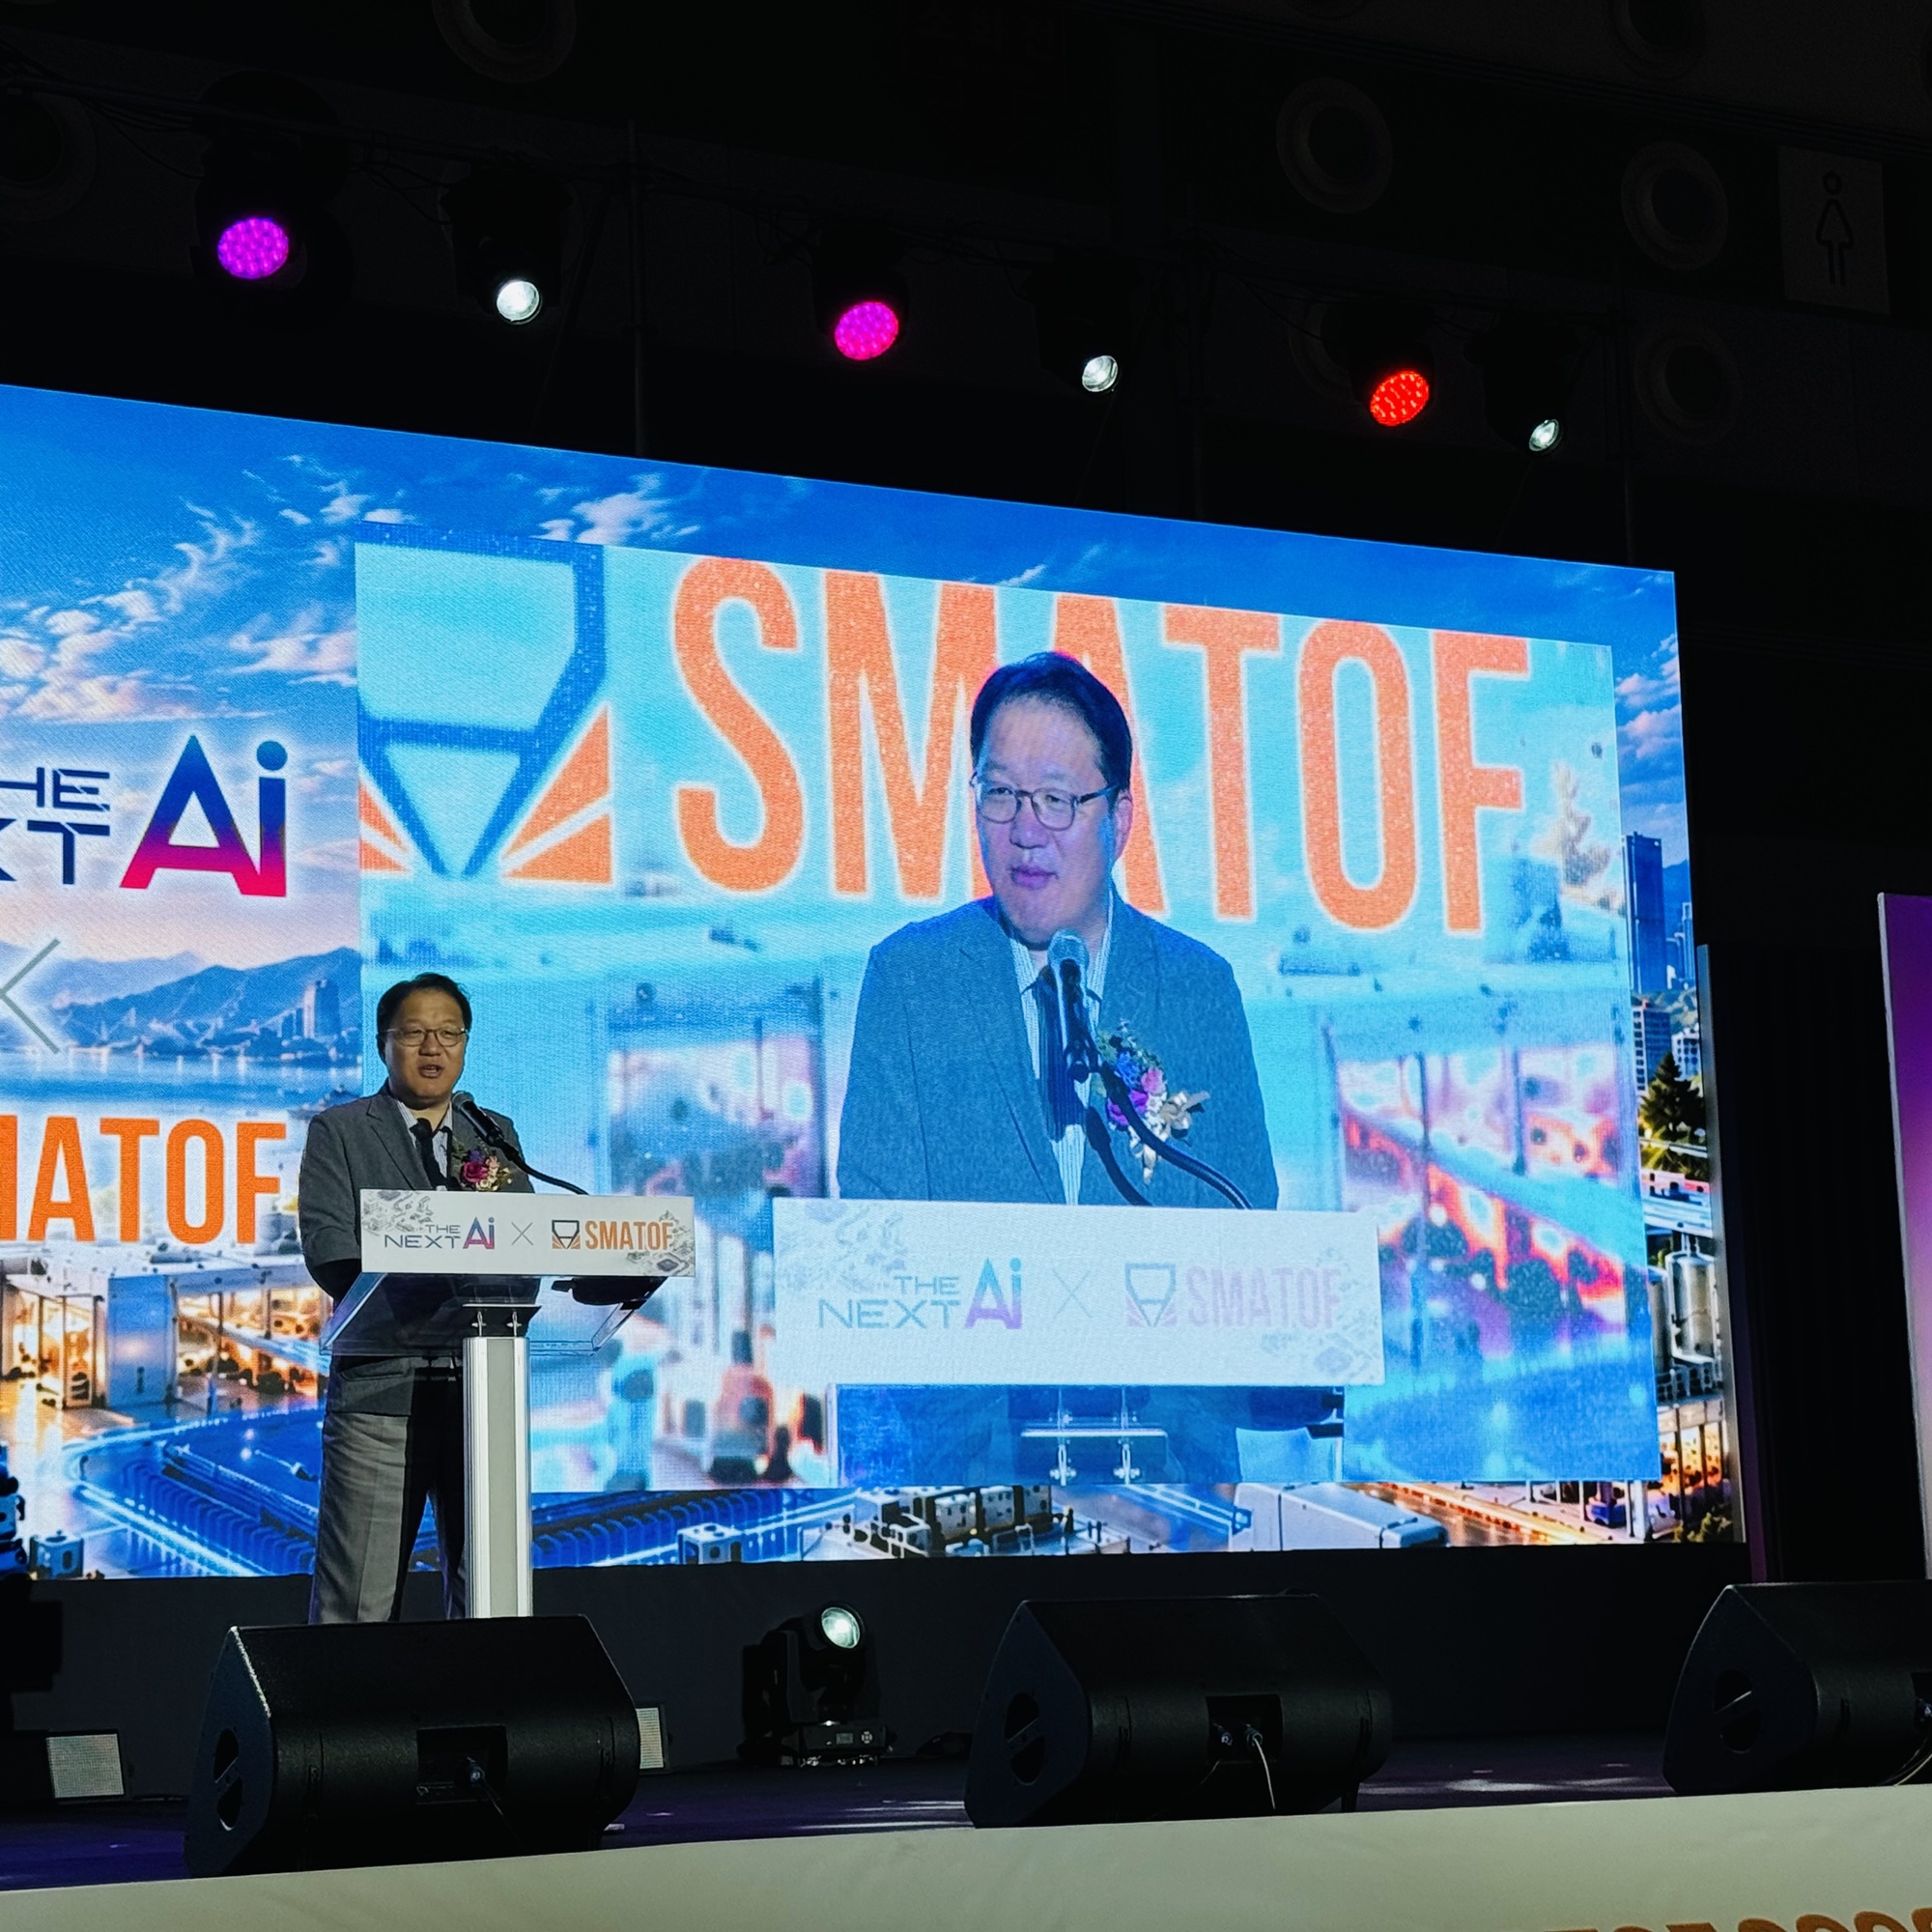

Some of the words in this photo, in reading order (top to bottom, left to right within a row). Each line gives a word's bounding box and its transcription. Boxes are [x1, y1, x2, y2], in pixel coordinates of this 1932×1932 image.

[384, 1234, 462, 1249] NEXT
[585, 1220, 673, 1251] SMATOF
[425, 1224, 461, 1235] THE
[818, 1299, 960, 1329] NEXT
[1186, 1266, 1341, 1329] SMATOF
[895, 1275, 958, 1295] THE
